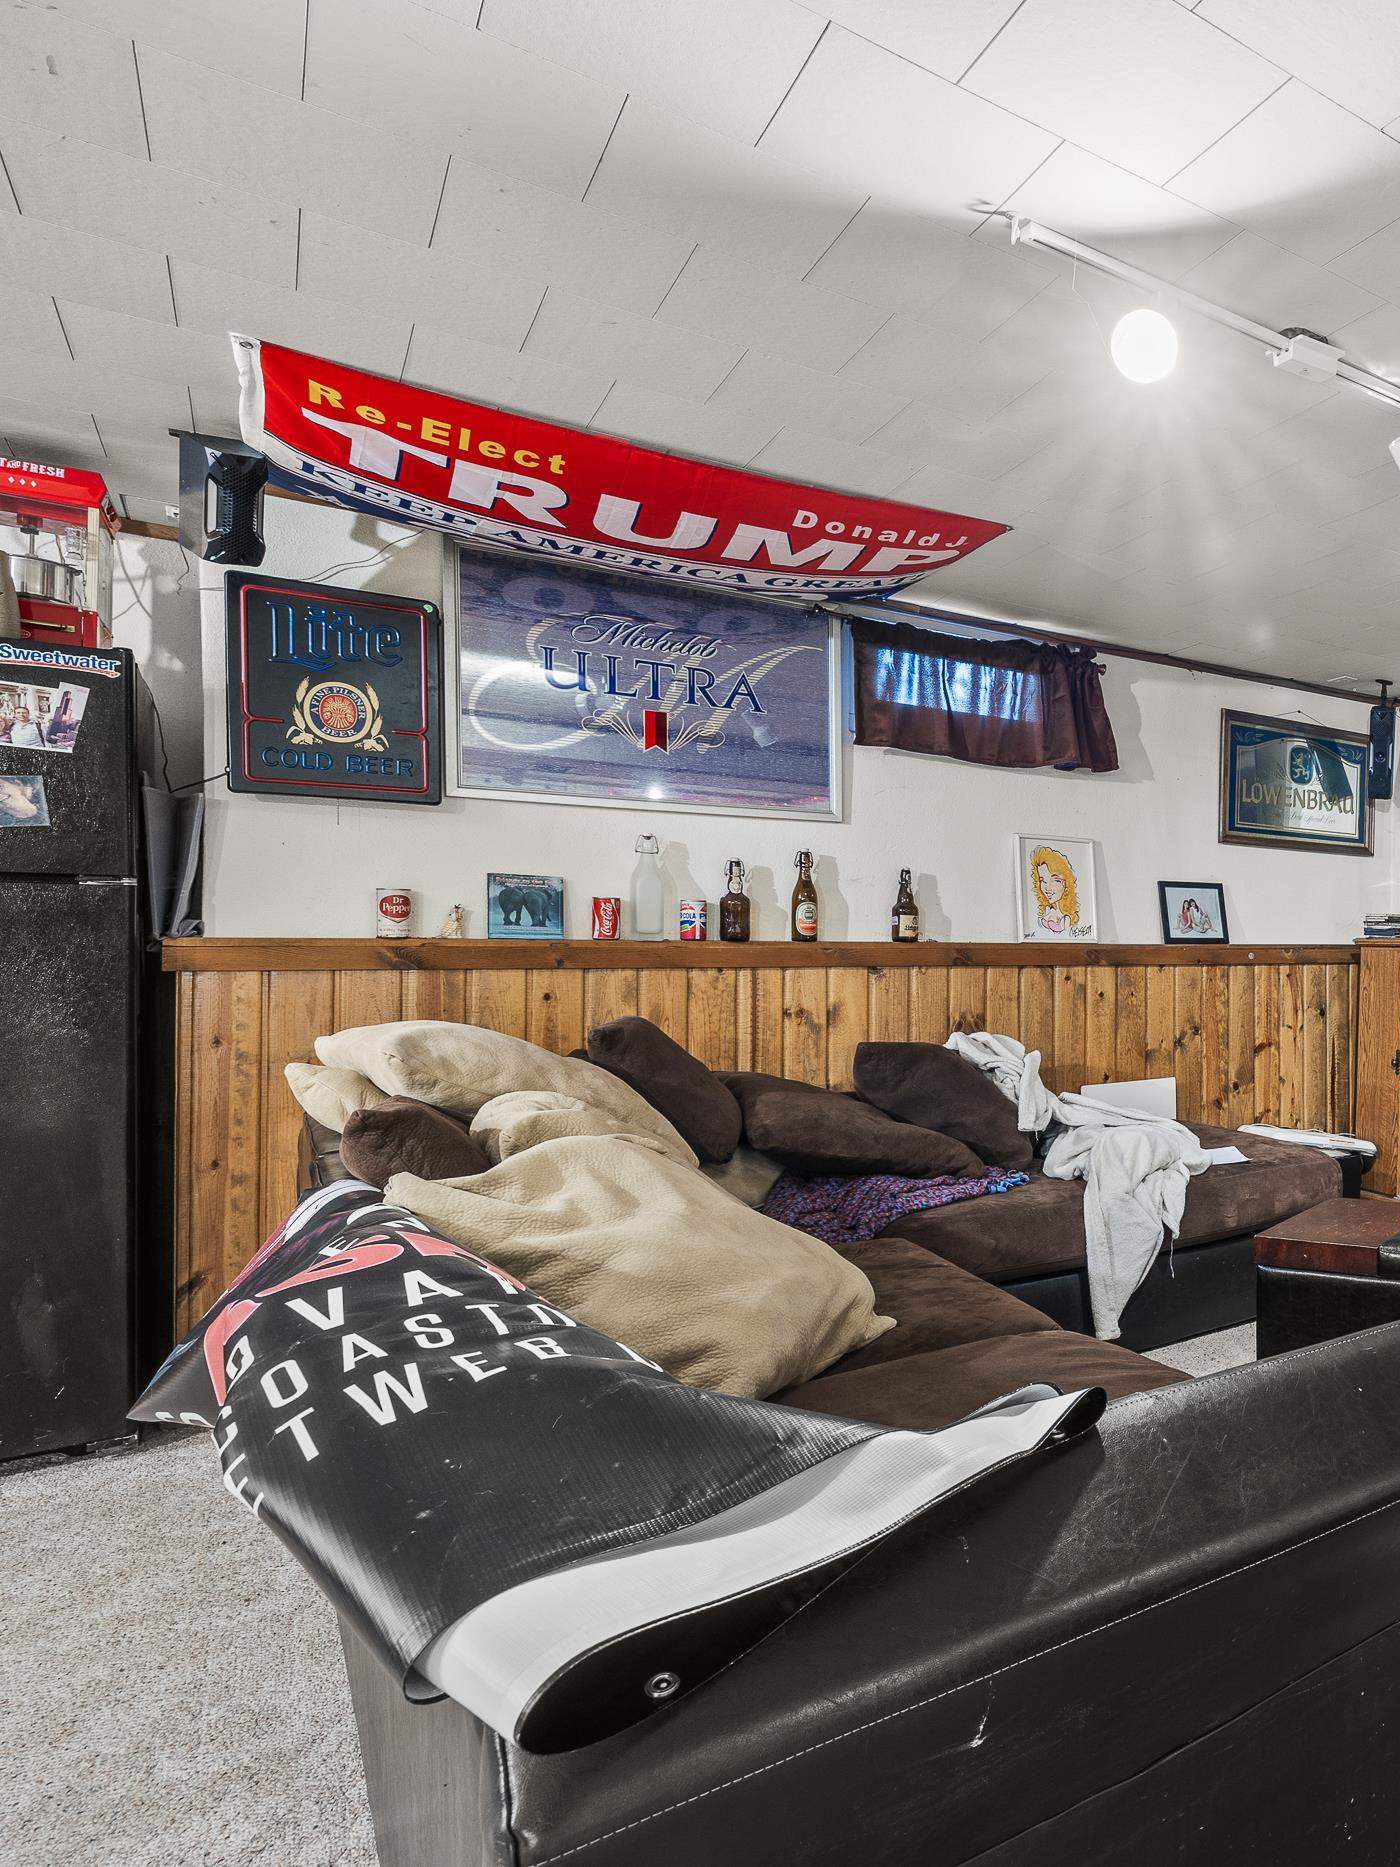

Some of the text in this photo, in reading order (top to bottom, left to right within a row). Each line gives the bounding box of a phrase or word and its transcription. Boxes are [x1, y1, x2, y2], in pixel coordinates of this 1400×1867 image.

[308, 378, 566, 475] Re-Elect
[22, 461, 65, 478] FRESH
[301, 406, 960, 573] TRUMP
[295, 456, 478, 528] KEEP
[487, 529, 750, 585] AMERICA
[792, 509, 941, 547] Donald
[265, 601, 403, 671] Lite
[570, 614, 723, 660] Michelob
[0, 643, 120, 672] Sweetwater
[539, 645, 767, 715] ULTRA
[321, 726, 358, 738] BEER
[261, 746, 414, 778] COLD BEER
[393, 896, 404, 904] Dr
